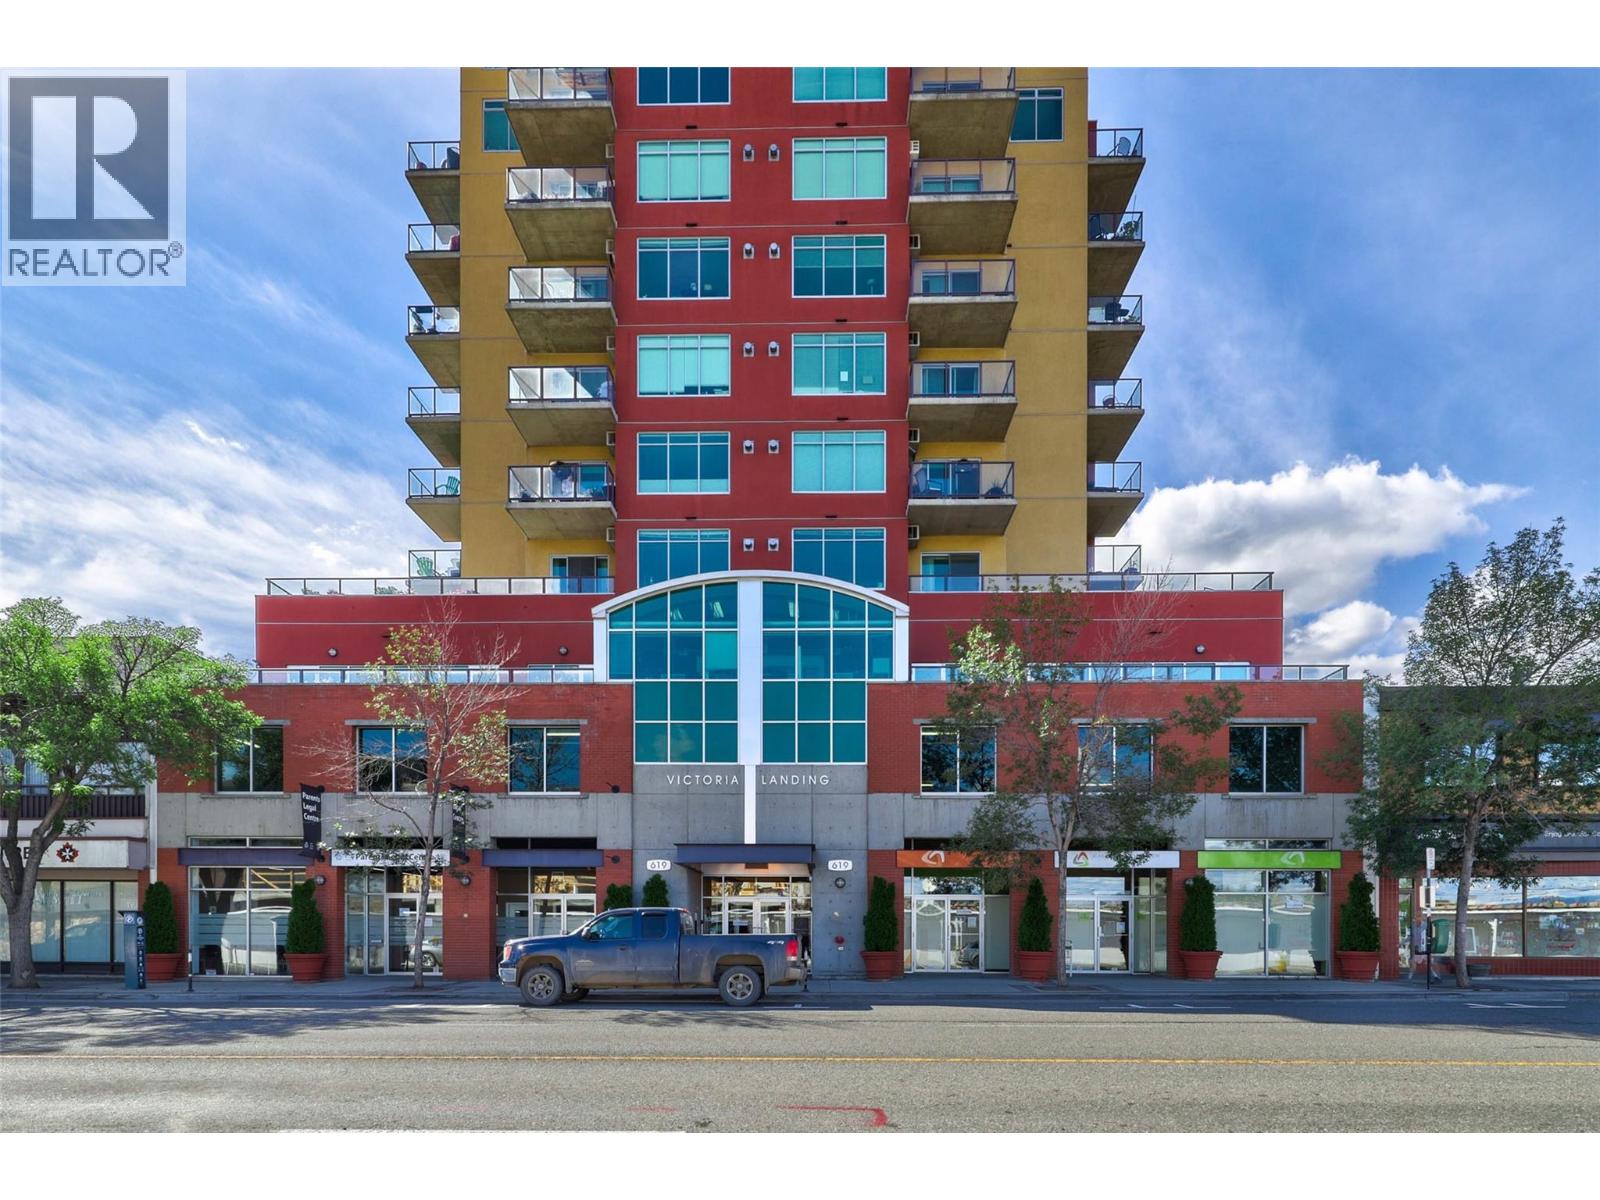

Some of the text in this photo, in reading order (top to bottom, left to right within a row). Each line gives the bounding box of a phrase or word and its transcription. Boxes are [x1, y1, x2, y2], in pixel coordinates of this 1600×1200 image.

[666, 774, 830, 785] VICTORIA LANDING
[302, 791, 321, 803] Parents
[302, 802, 317, 813] Legal
[650, 861, 667, 870] 619
[831, 861, 849, 870] 619
